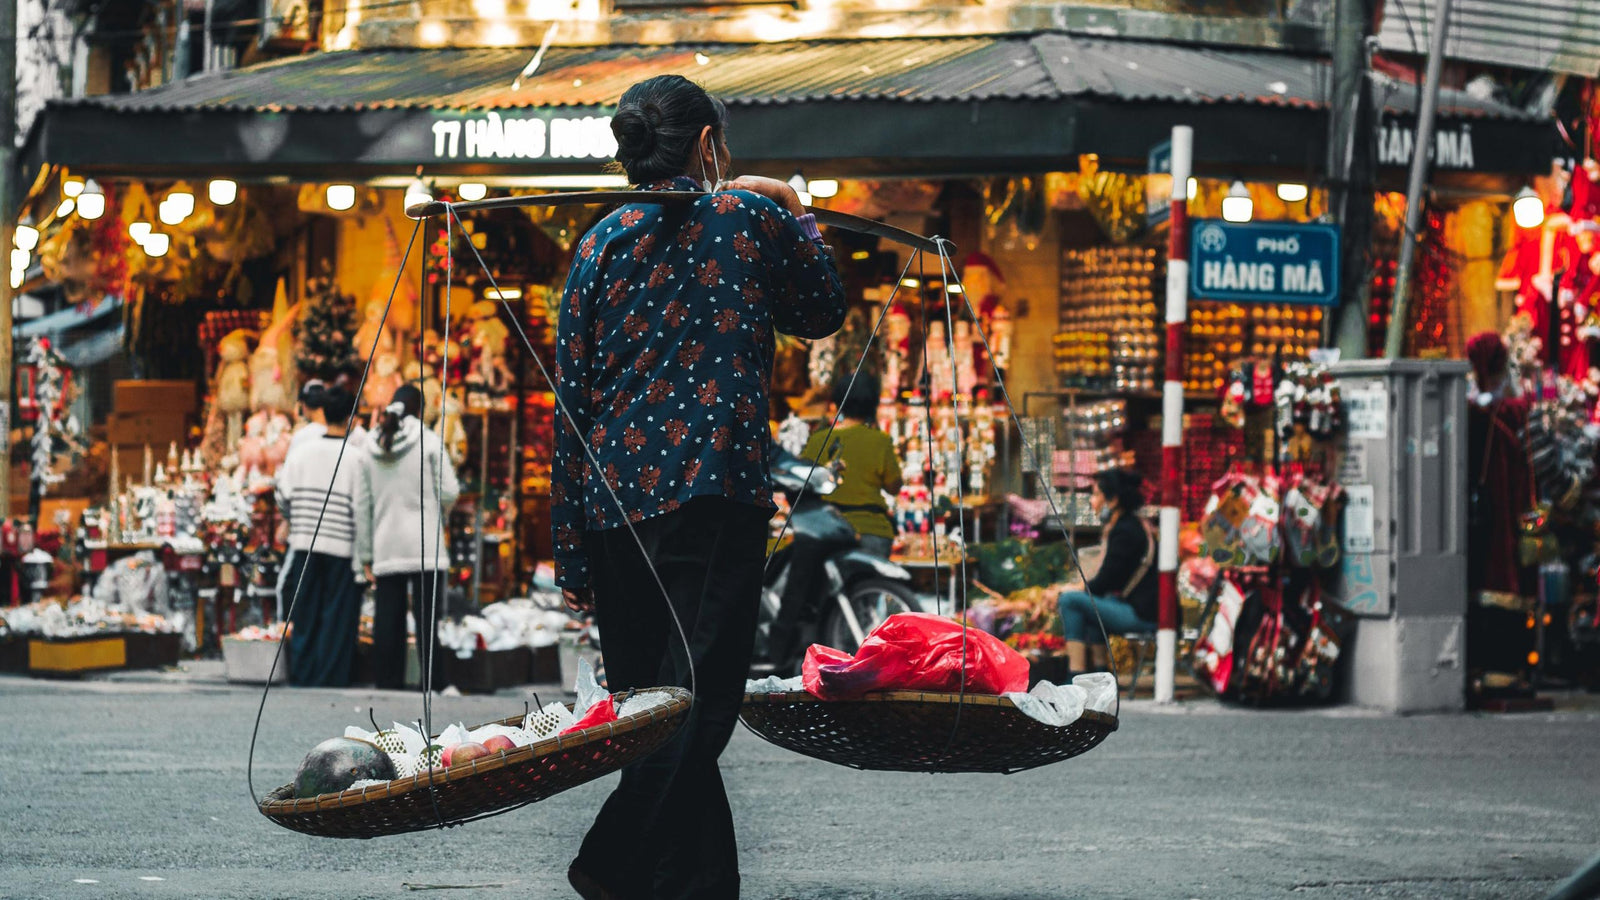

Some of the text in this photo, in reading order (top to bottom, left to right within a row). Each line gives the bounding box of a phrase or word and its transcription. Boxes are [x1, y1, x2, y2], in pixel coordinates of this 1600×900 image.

[432, 120, 461, 158] 17
[465, 112, 546, 159] HÀNG
[1257, 233, 1300, 255] PHỐ
[1203, 254, 1325, 293] HÀNG MÃ
